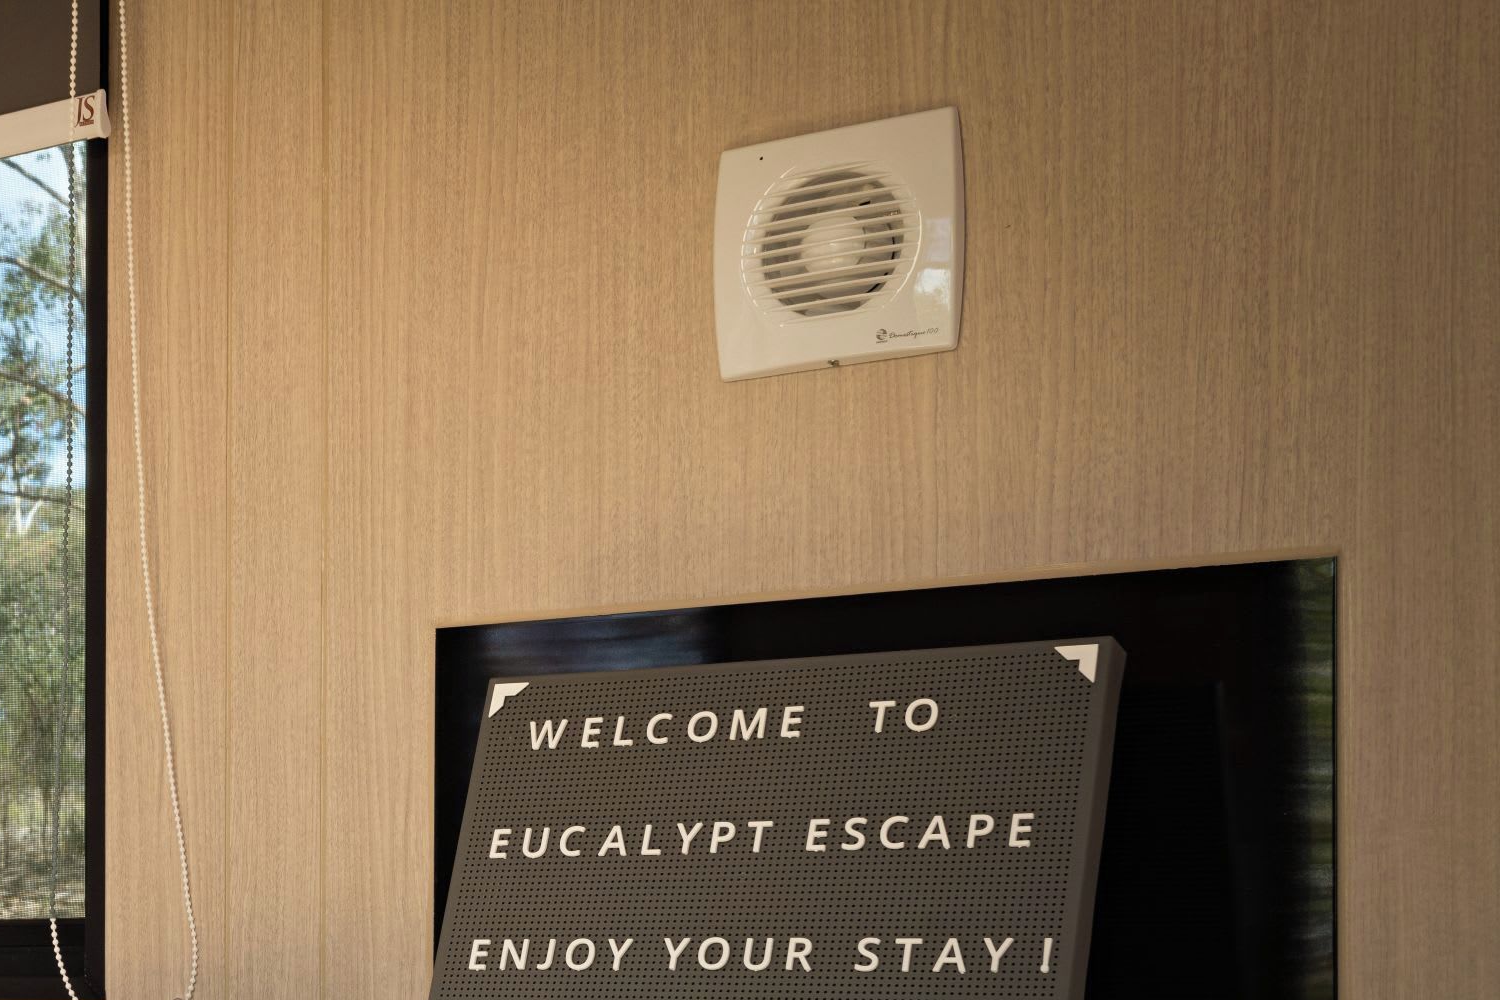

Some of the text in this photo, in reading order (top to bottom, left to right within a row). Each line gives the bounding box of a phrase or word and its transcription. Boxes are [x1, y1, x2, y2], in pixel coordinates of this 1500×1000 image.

[527, 697, 939, 750] WELCOME TO
[487, 811, 1036, 860] EUCALYPT ESCAPE
[467, 936, 634, 973] ENJOY
[663, 935, 814, 973] YOUR
